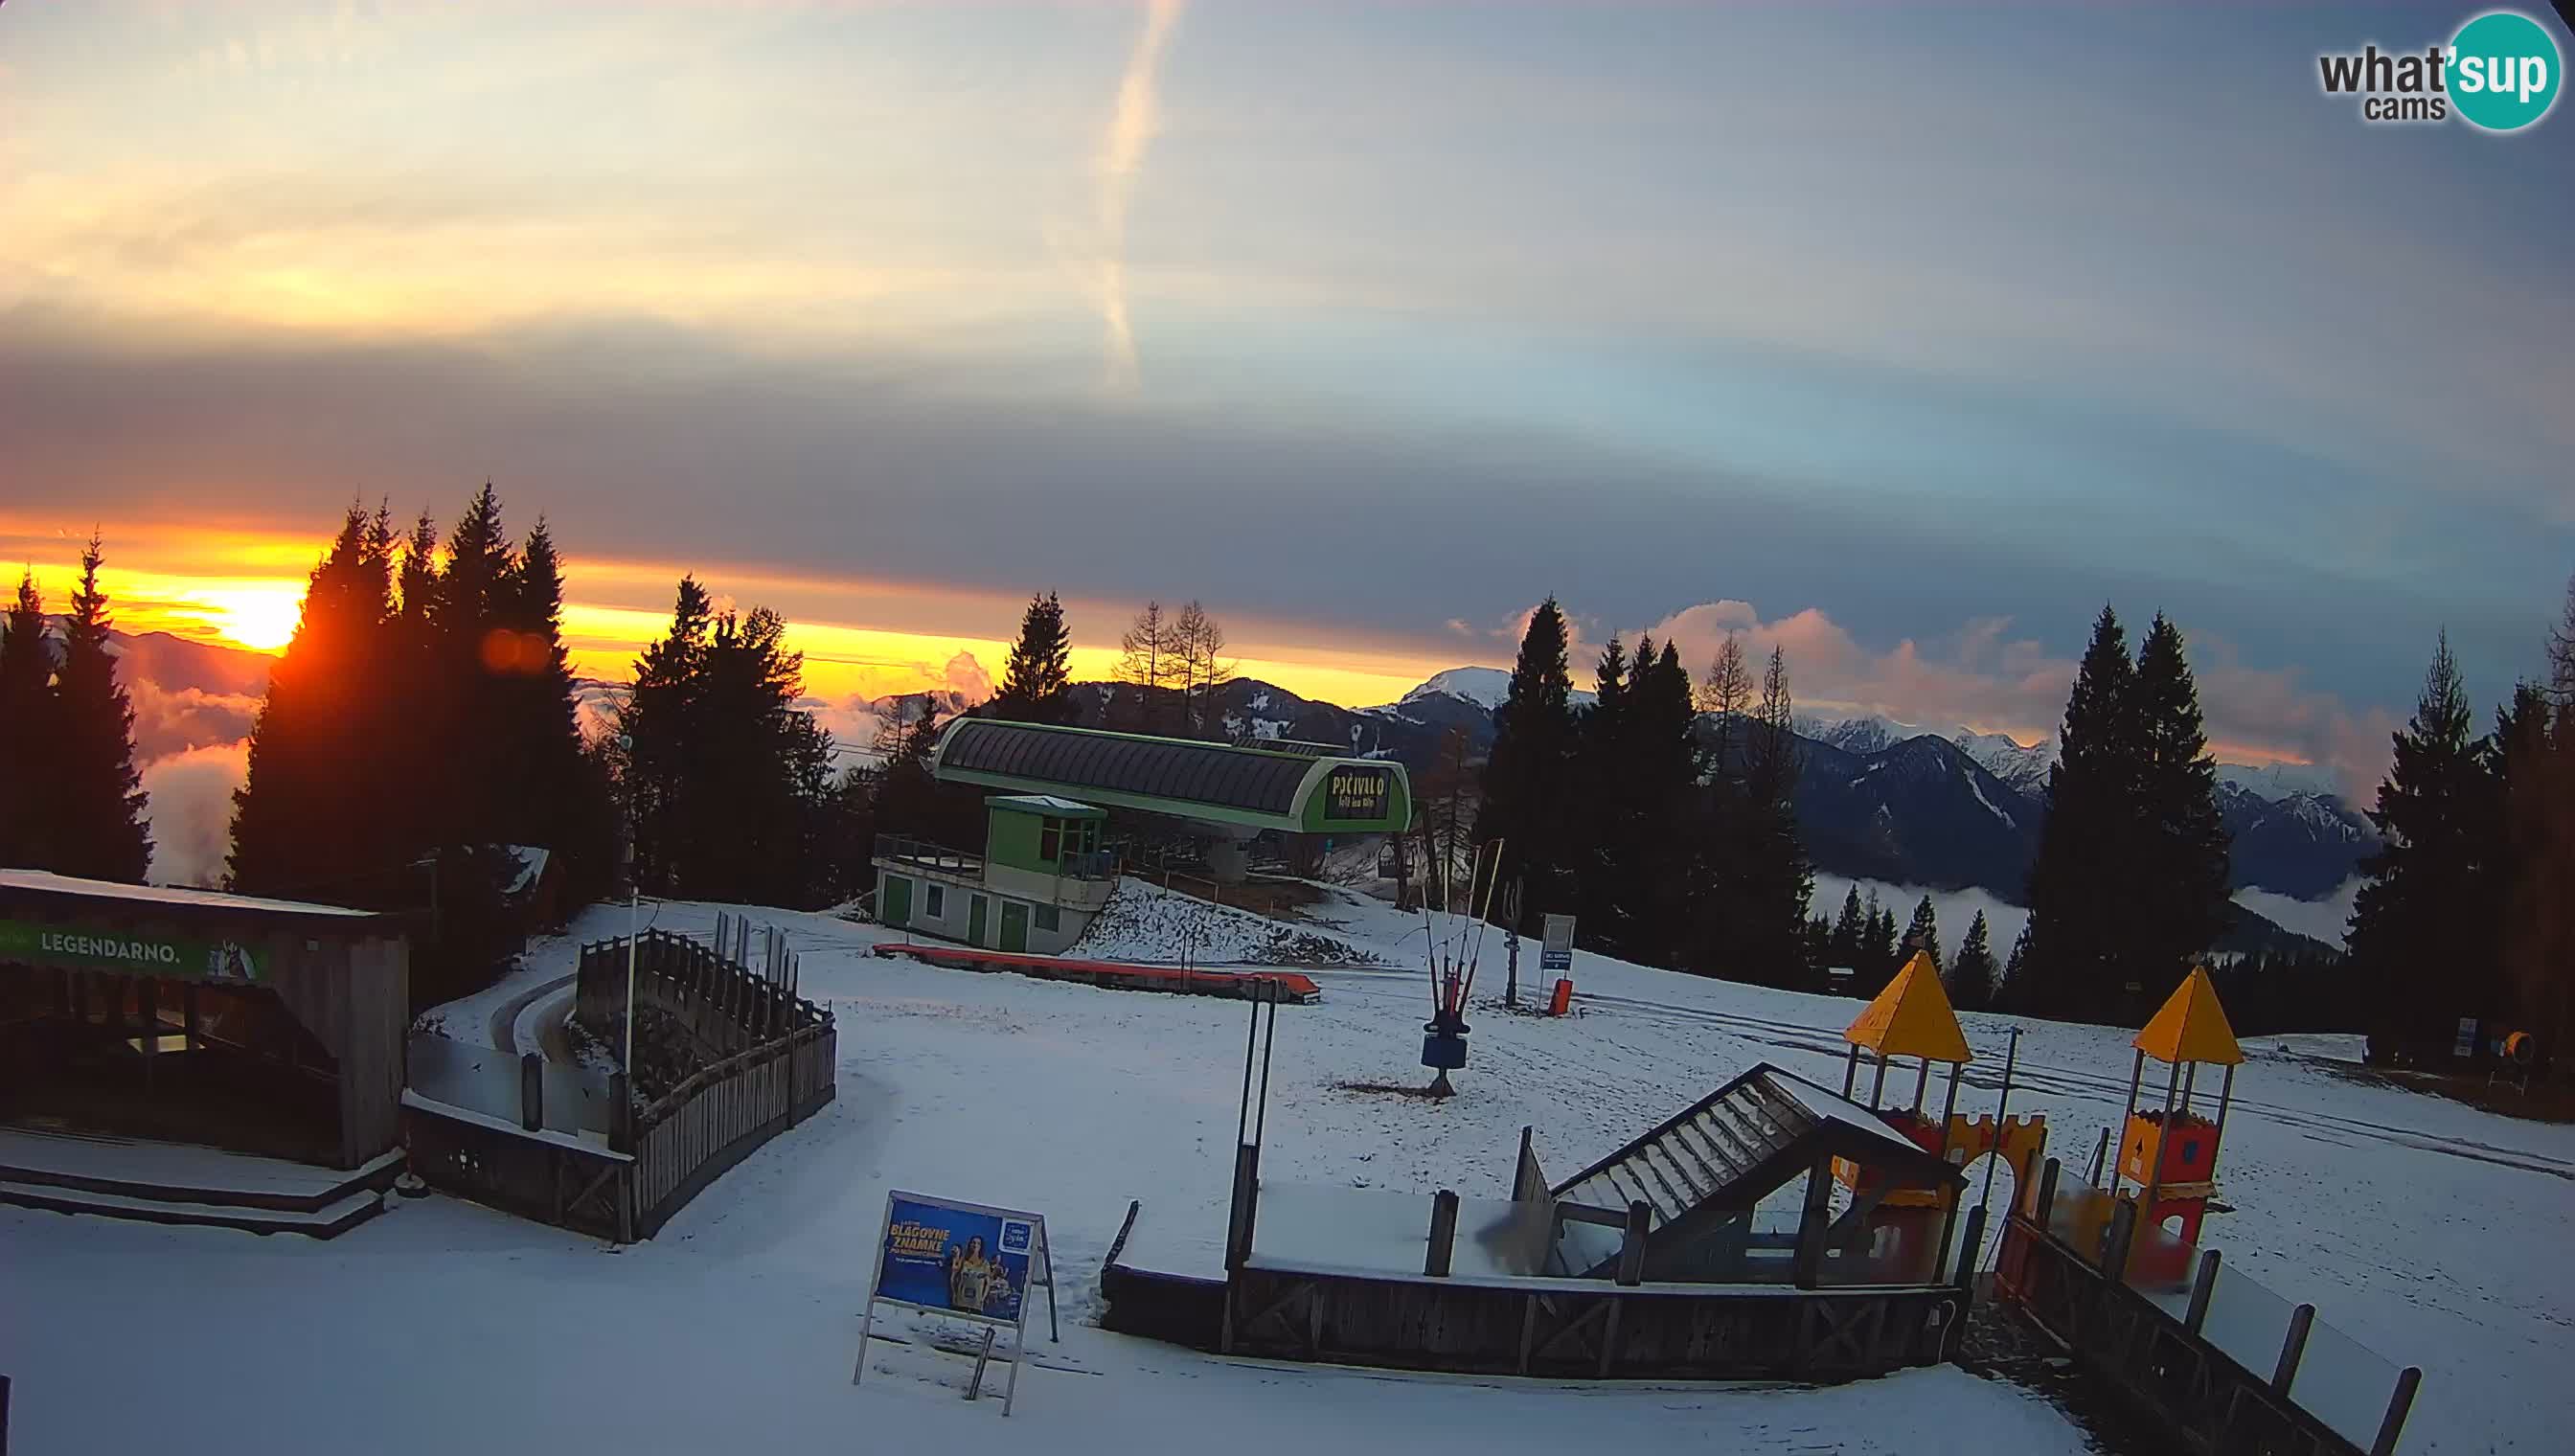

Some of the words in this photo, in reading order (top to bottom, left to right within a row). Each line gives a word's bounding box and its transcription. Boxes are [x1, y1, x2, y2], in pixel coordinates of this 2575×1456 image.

[41, 932, 181, 964] LEGENDARNO.
[891, 1224, 950, 1240] BLAGOVNE
[894, 1237, 943, 1251] ZNAMKE
